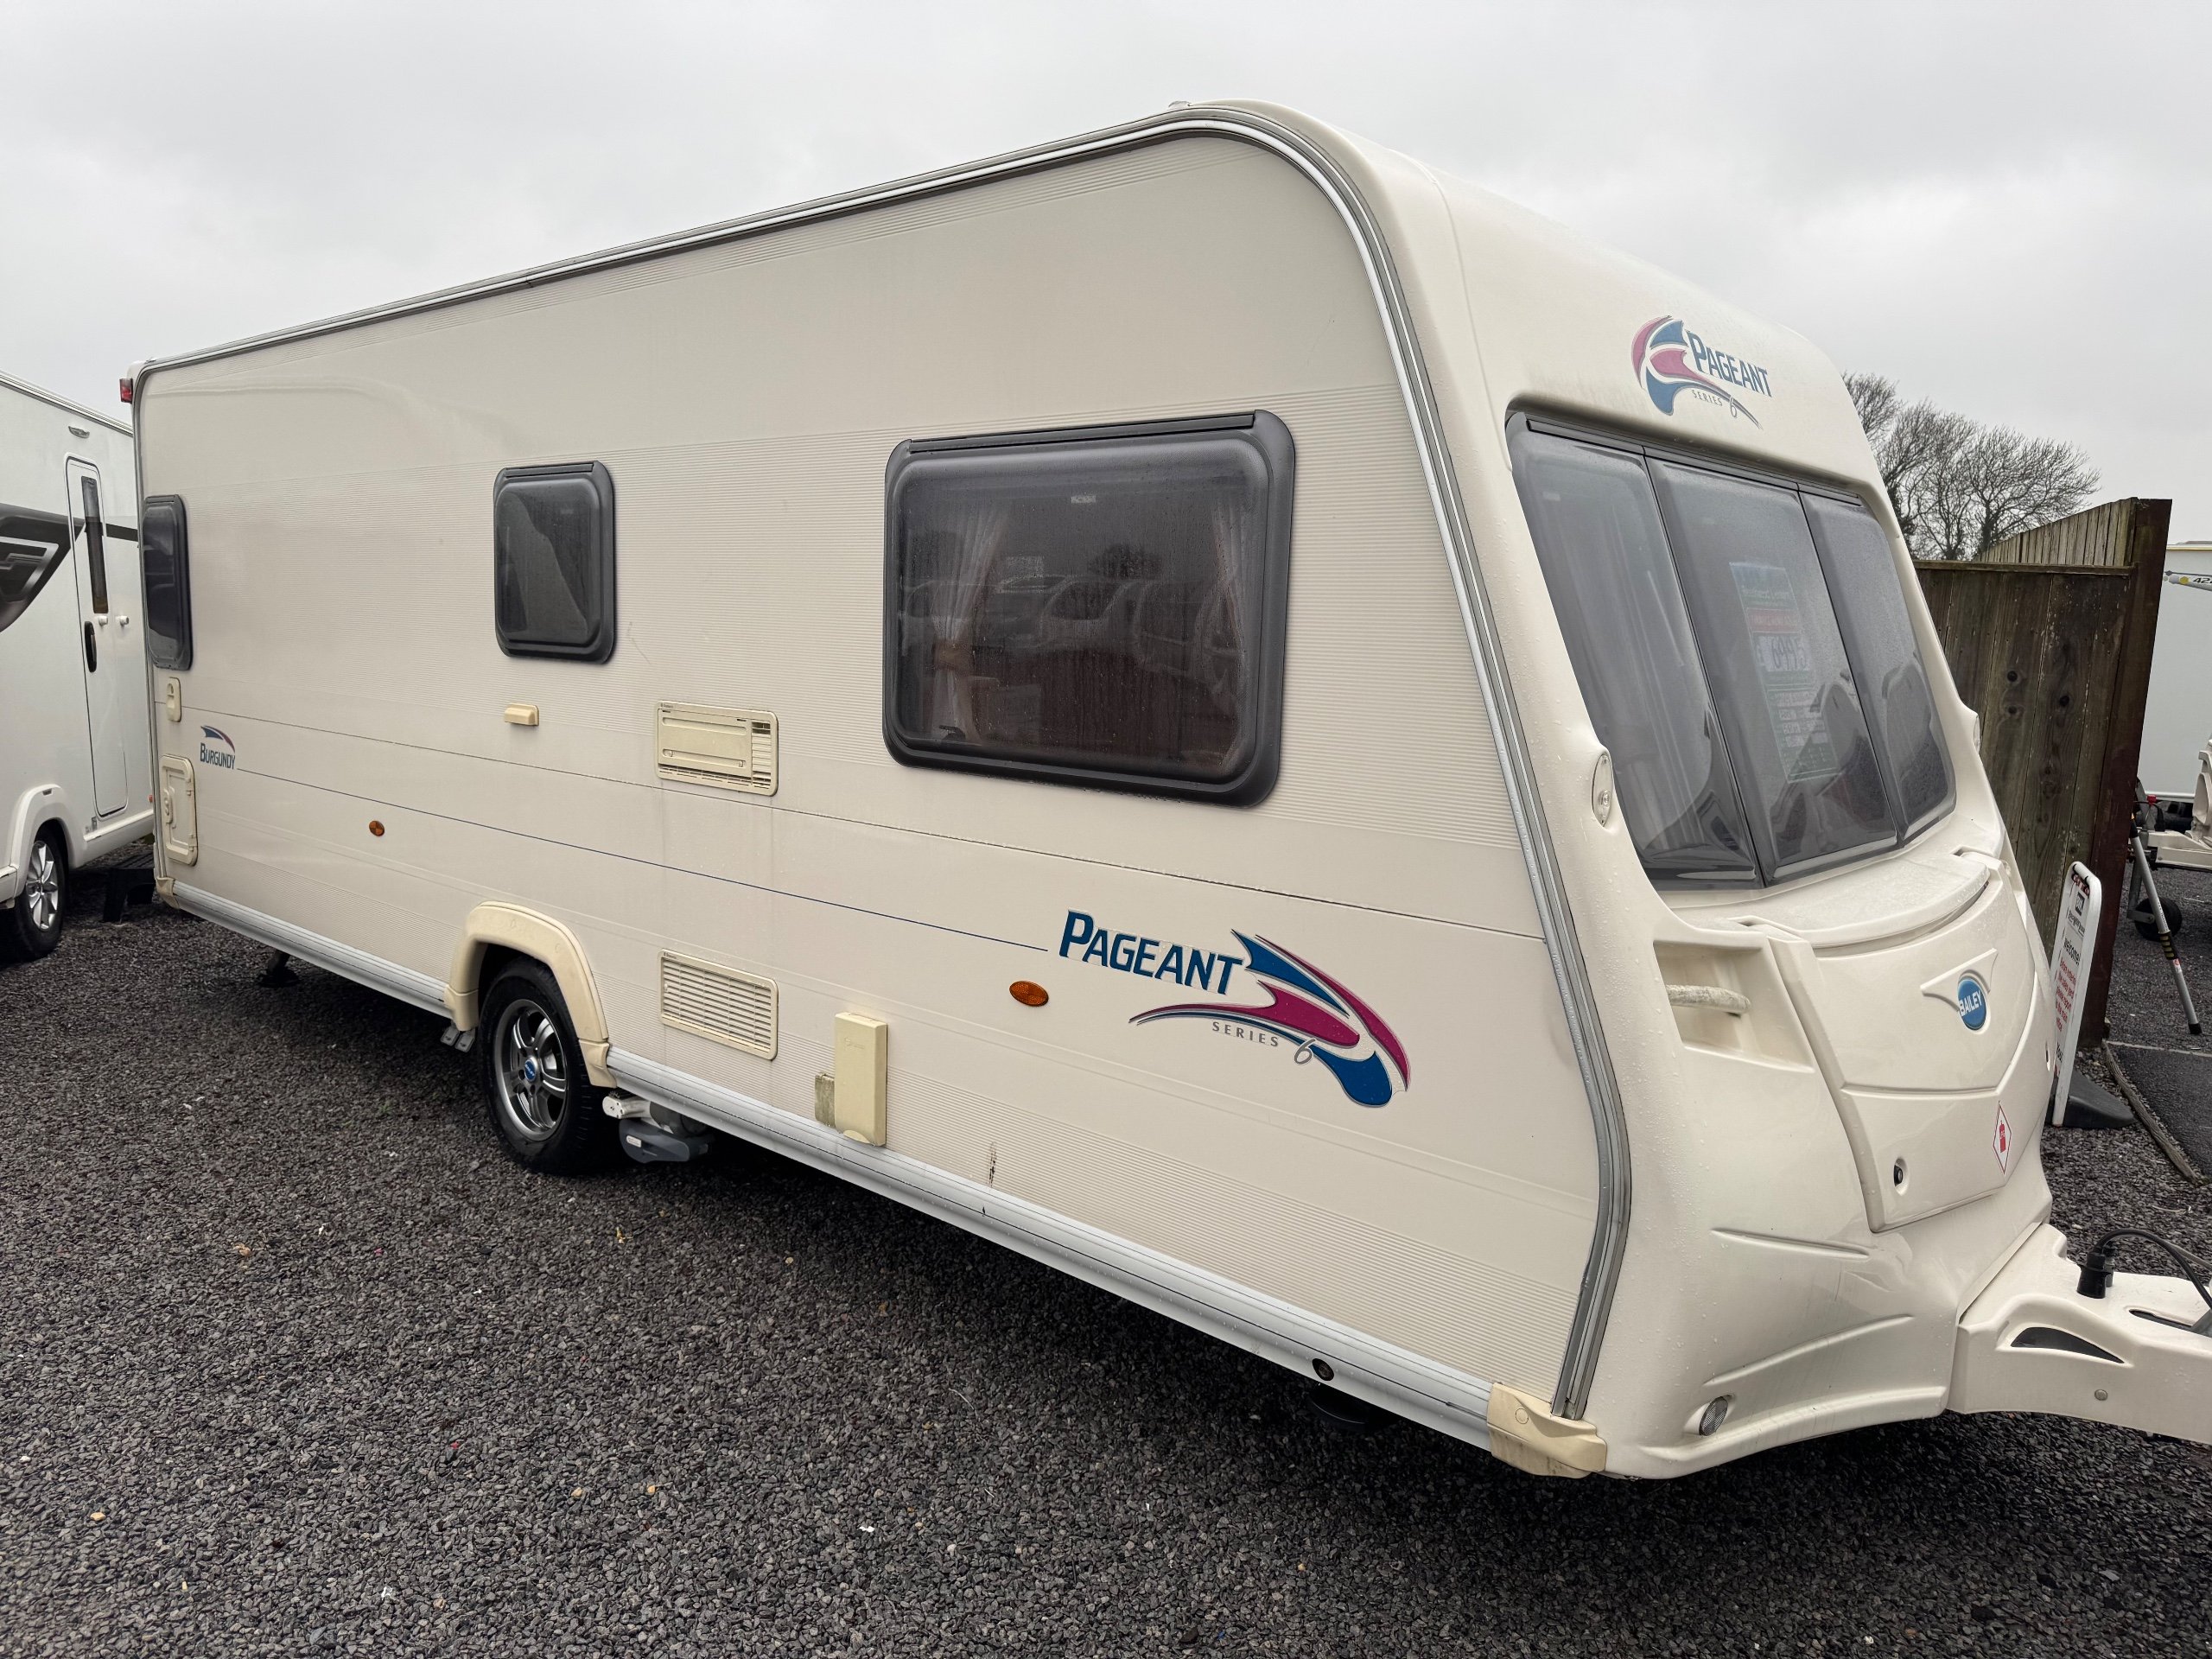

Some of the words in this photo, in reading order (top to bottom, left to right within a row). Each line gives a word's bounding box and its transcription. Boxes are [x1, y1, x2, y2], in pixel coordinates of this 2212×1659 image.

[1685, 328, 1772, 397] PAGEANT
[1691, 389, 1723, 407] SERIES
[1730, 397, 1738, 418] 6
[200, 741, 236, 770] BURGUNDY
[1058, 909, 1244, 995] PAGEANT
[1959, 989, 1982, 1017] BAILEY
[1212, 1020, 1279, 1047] SERIES
[1294, 1038, 1316, 1065] 6
